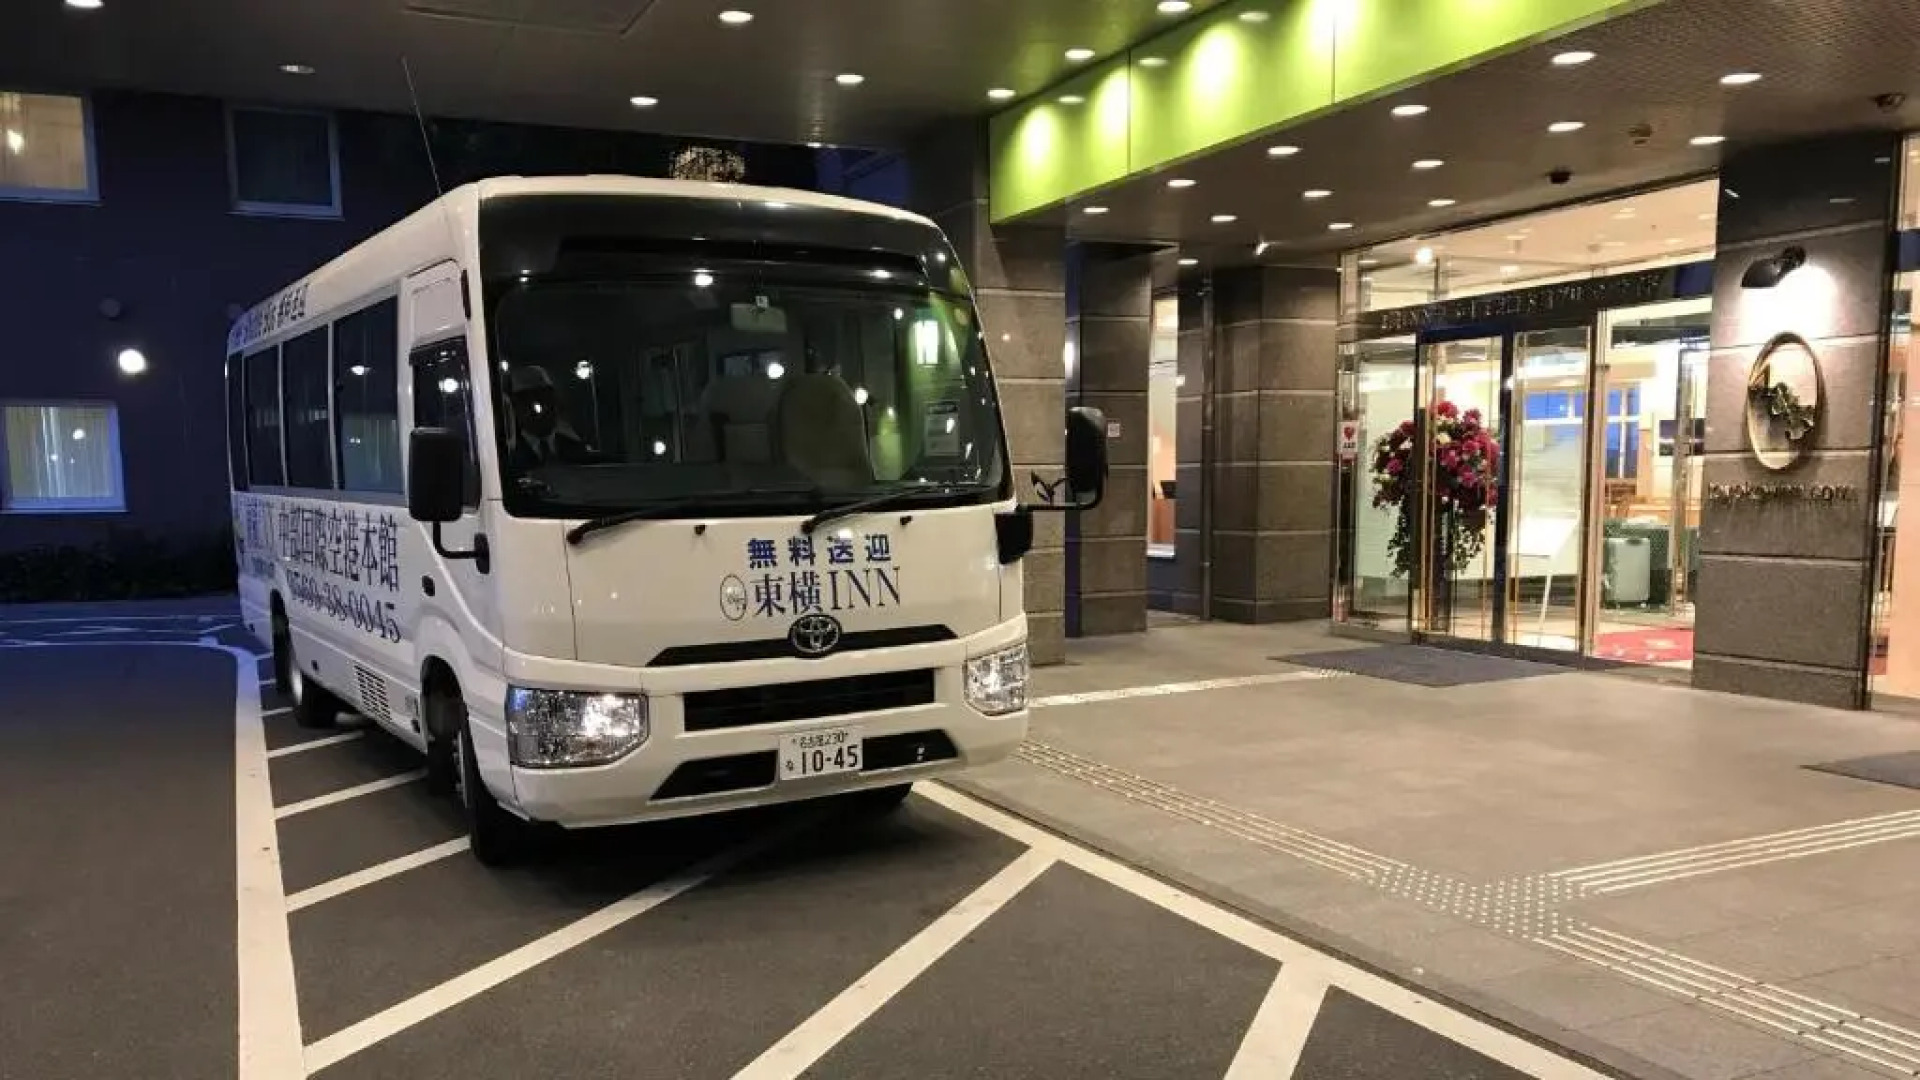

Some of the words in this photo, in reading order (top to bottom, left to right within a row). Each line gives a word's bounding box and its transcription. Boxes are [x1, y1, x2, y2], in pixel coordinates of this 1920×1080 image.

[748, 533, 892, 569] 無料送迎
[750, 566, 901, 618] 東横INN
[802, 744, 858, 775] 10-45
